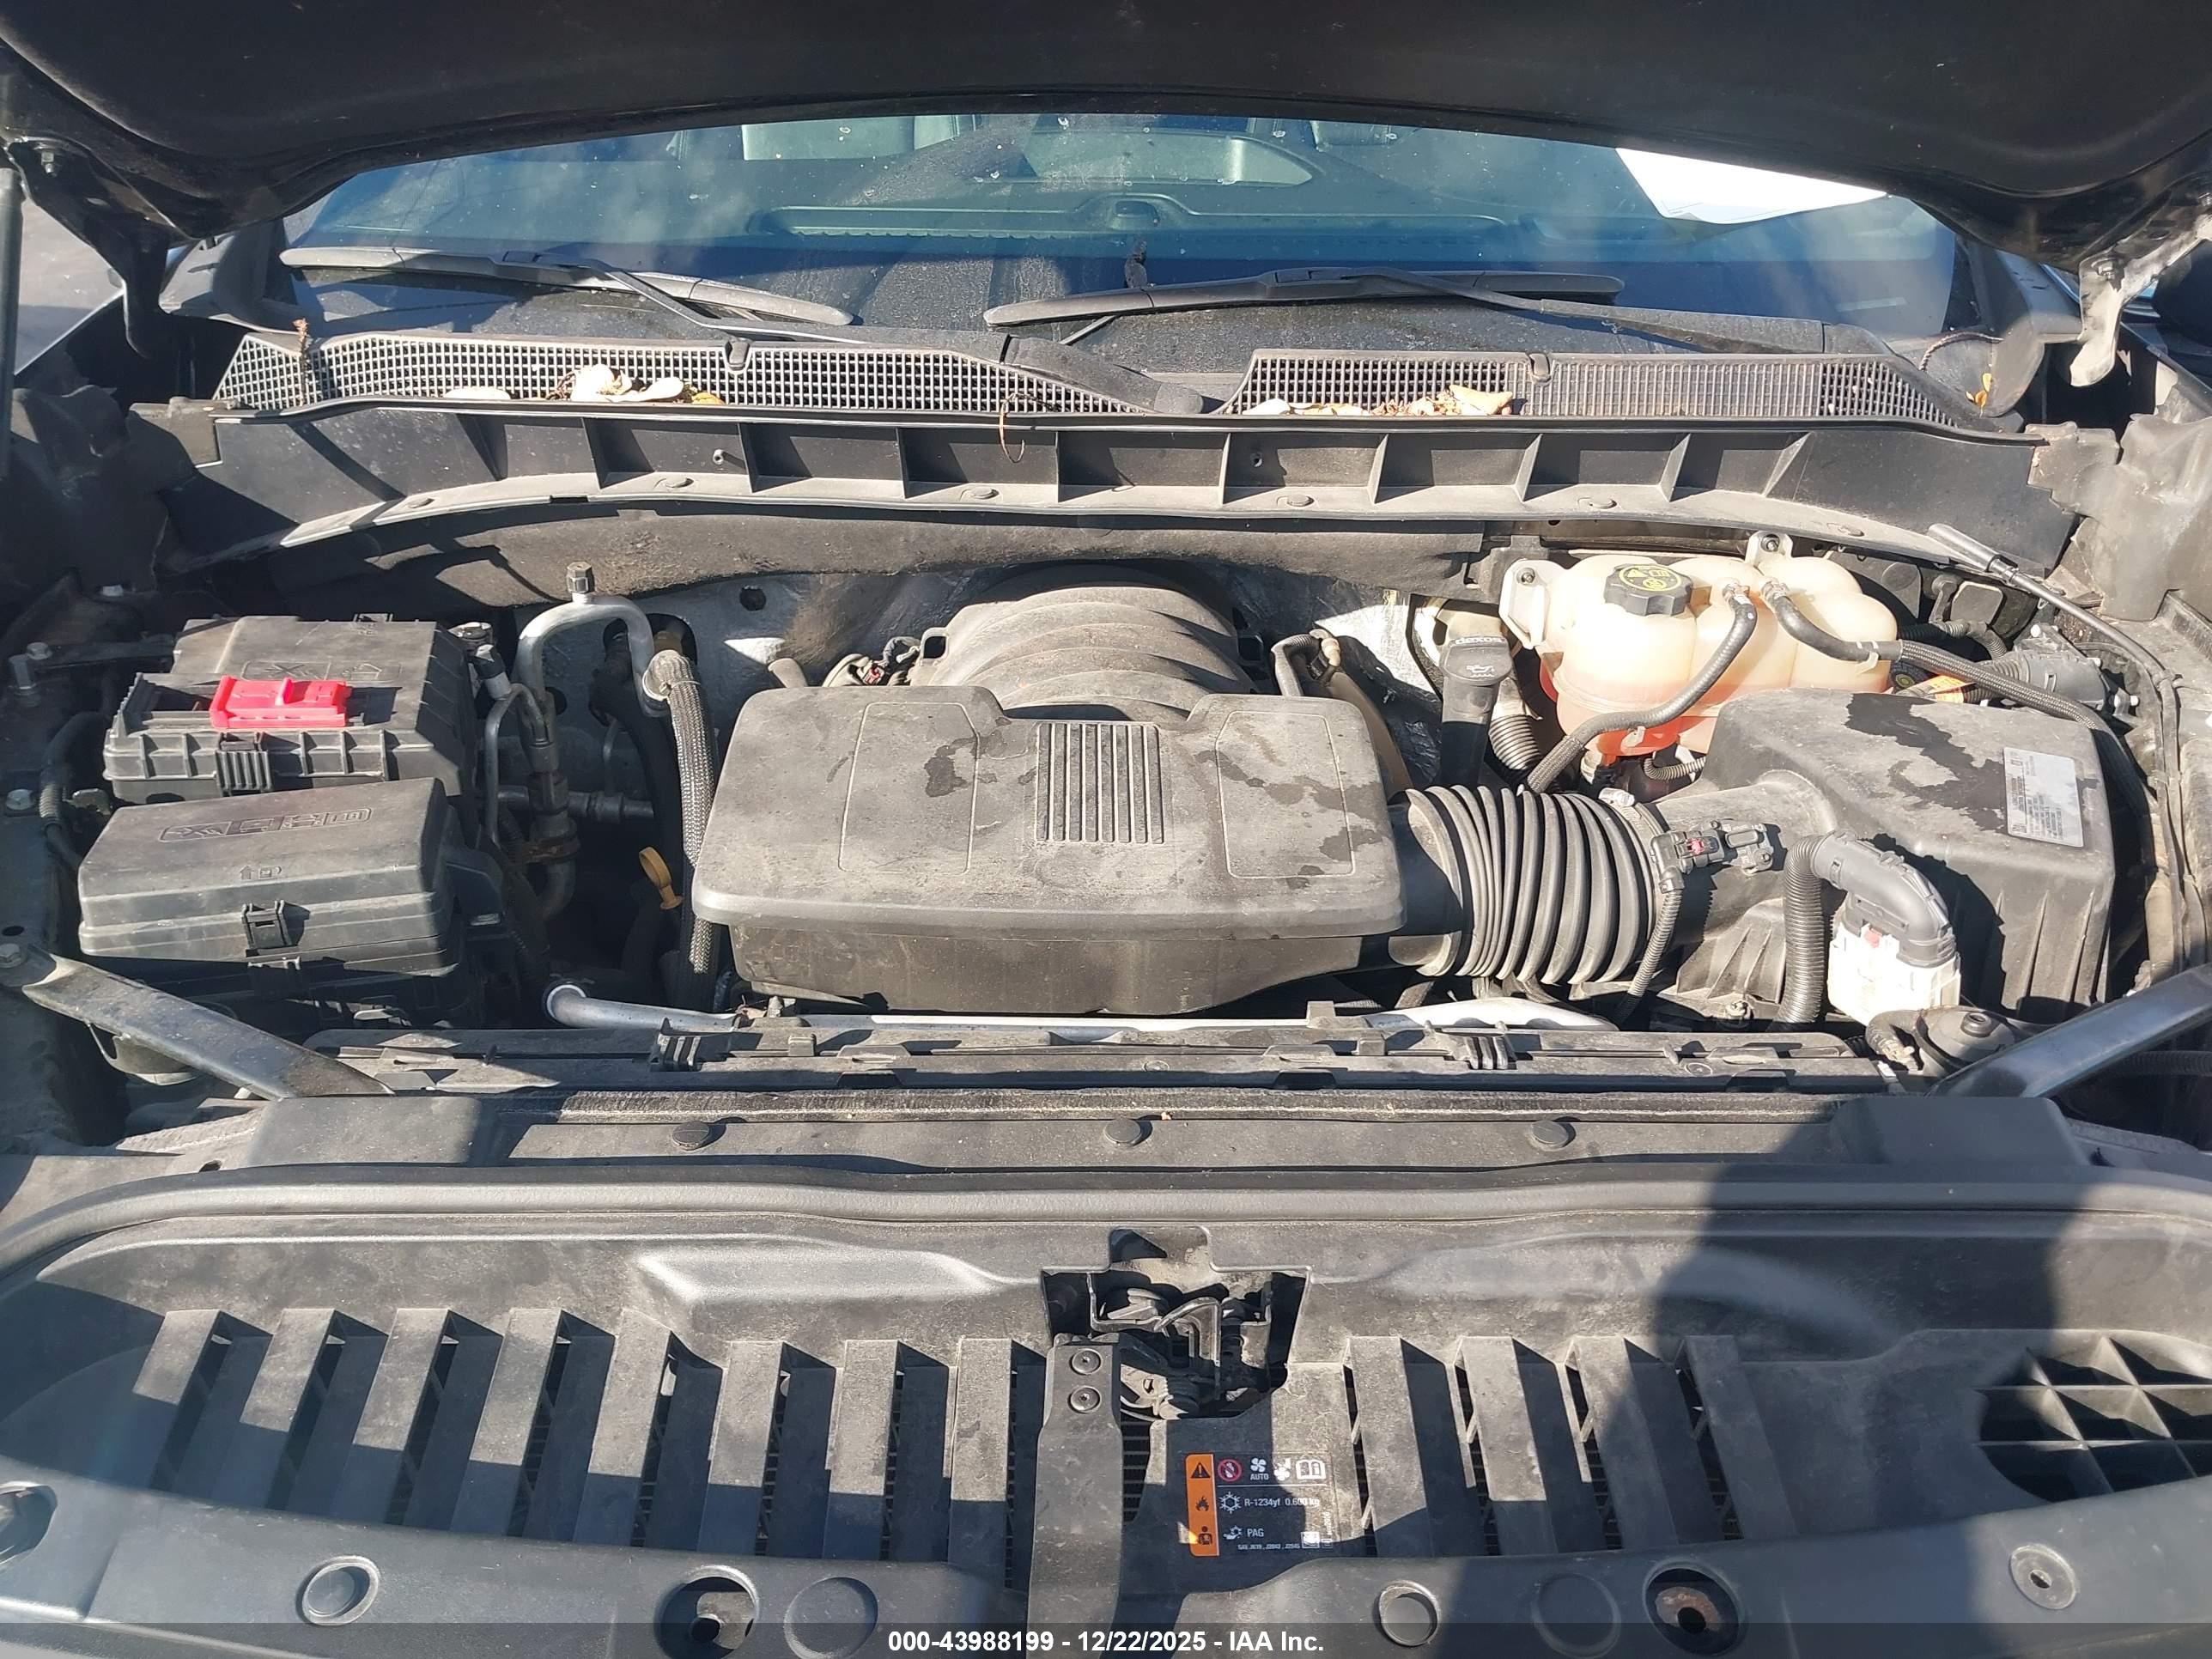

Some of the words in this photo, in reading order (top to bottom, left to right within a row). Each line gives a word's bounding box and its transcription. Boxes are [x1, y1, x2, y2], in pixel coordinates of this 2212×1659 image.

[1244, 1498, 1280, 1507] R-1234yf
[1309, 1498, 1320, 1507] kg
[1247, 1528, 1264, 1537] PAG
